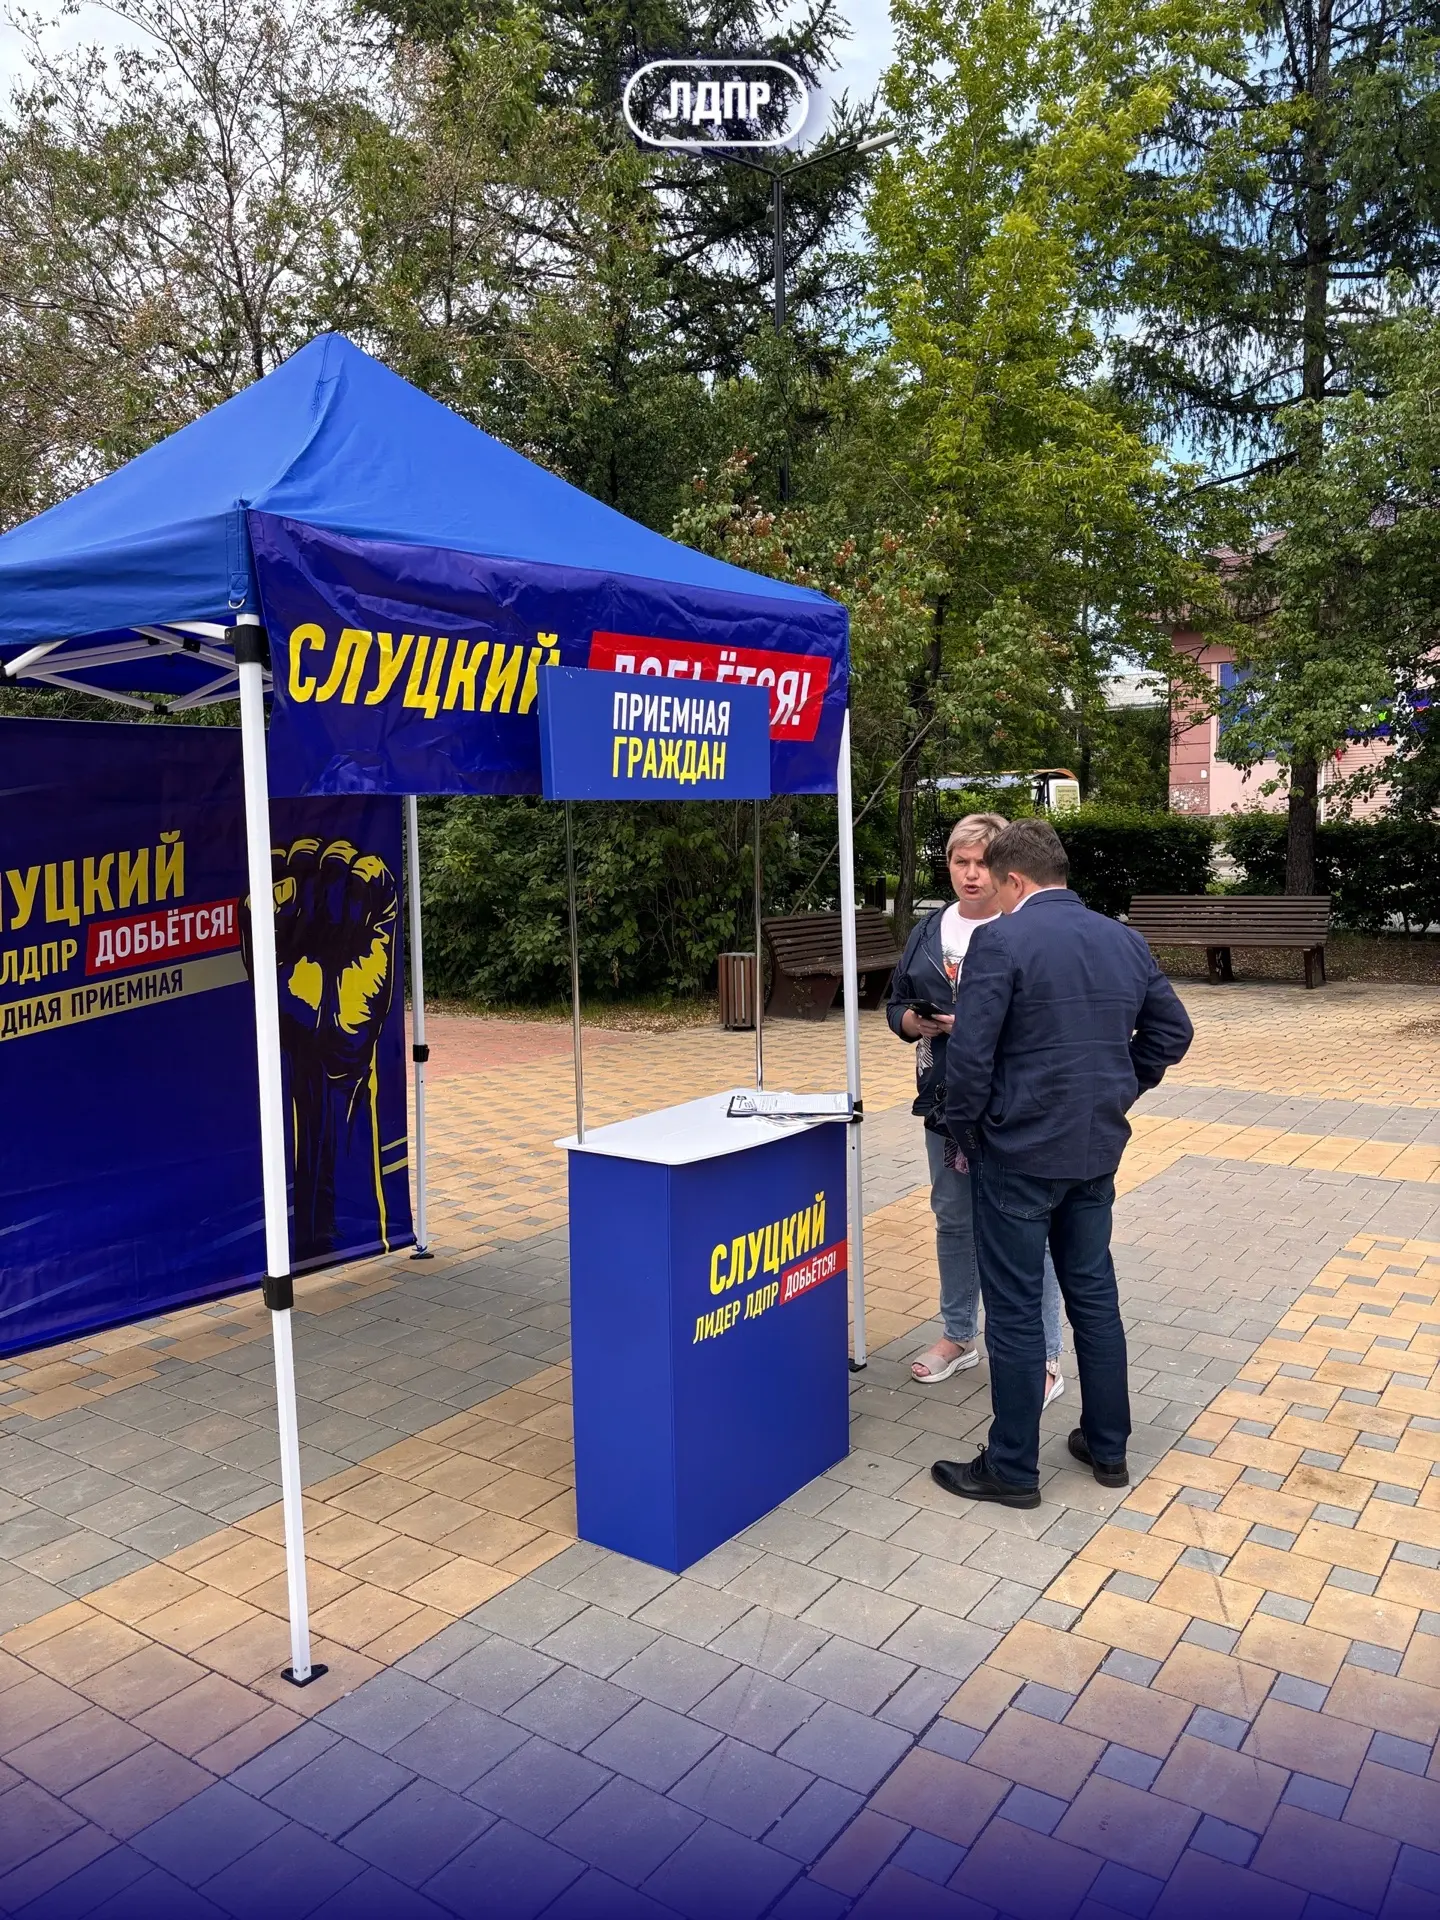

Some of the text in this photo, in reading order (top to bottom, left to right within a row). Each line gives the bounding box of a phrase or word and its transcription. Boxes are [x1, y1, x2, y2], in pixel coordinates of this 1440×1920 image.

[288, 622, 561, 719] СЛУЦКИЙ
[612, 691, 731, 736] ПРИЕМНАЯ
[612, 736, 727, 785] ГРАЖДАН
[0, 829, 185, 932] УЦКИЙ
[0, 904, 234, 986] ЛДПР ДОБЬЁТСЯ!
[71, 968, 183, 1018] ПРИЕМНАЯ
[709, 1190, 826, 1297] СЛУЦКИЙ
[693, 1250, 837, 1345] ЛИДЕР ЛДПР ДОБЬЁТСЯ!
